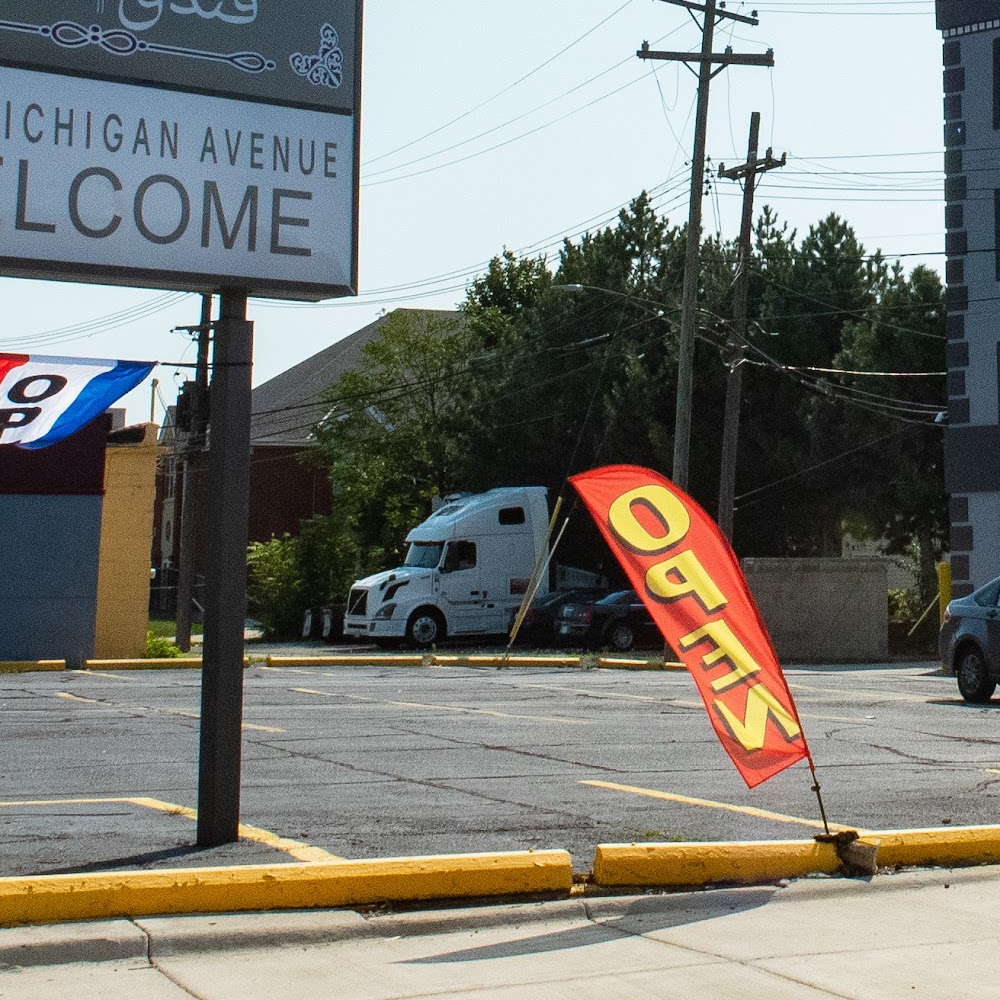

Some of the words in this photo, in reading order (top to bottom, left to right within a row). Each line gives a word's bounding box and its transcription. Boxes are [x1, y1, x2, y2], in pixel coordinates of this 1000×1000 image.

[4, 100, 179, 160] ICHIGAN
[200, 126, 338, 179] AVENUE
[0, 156, 313, 257] LCOME
